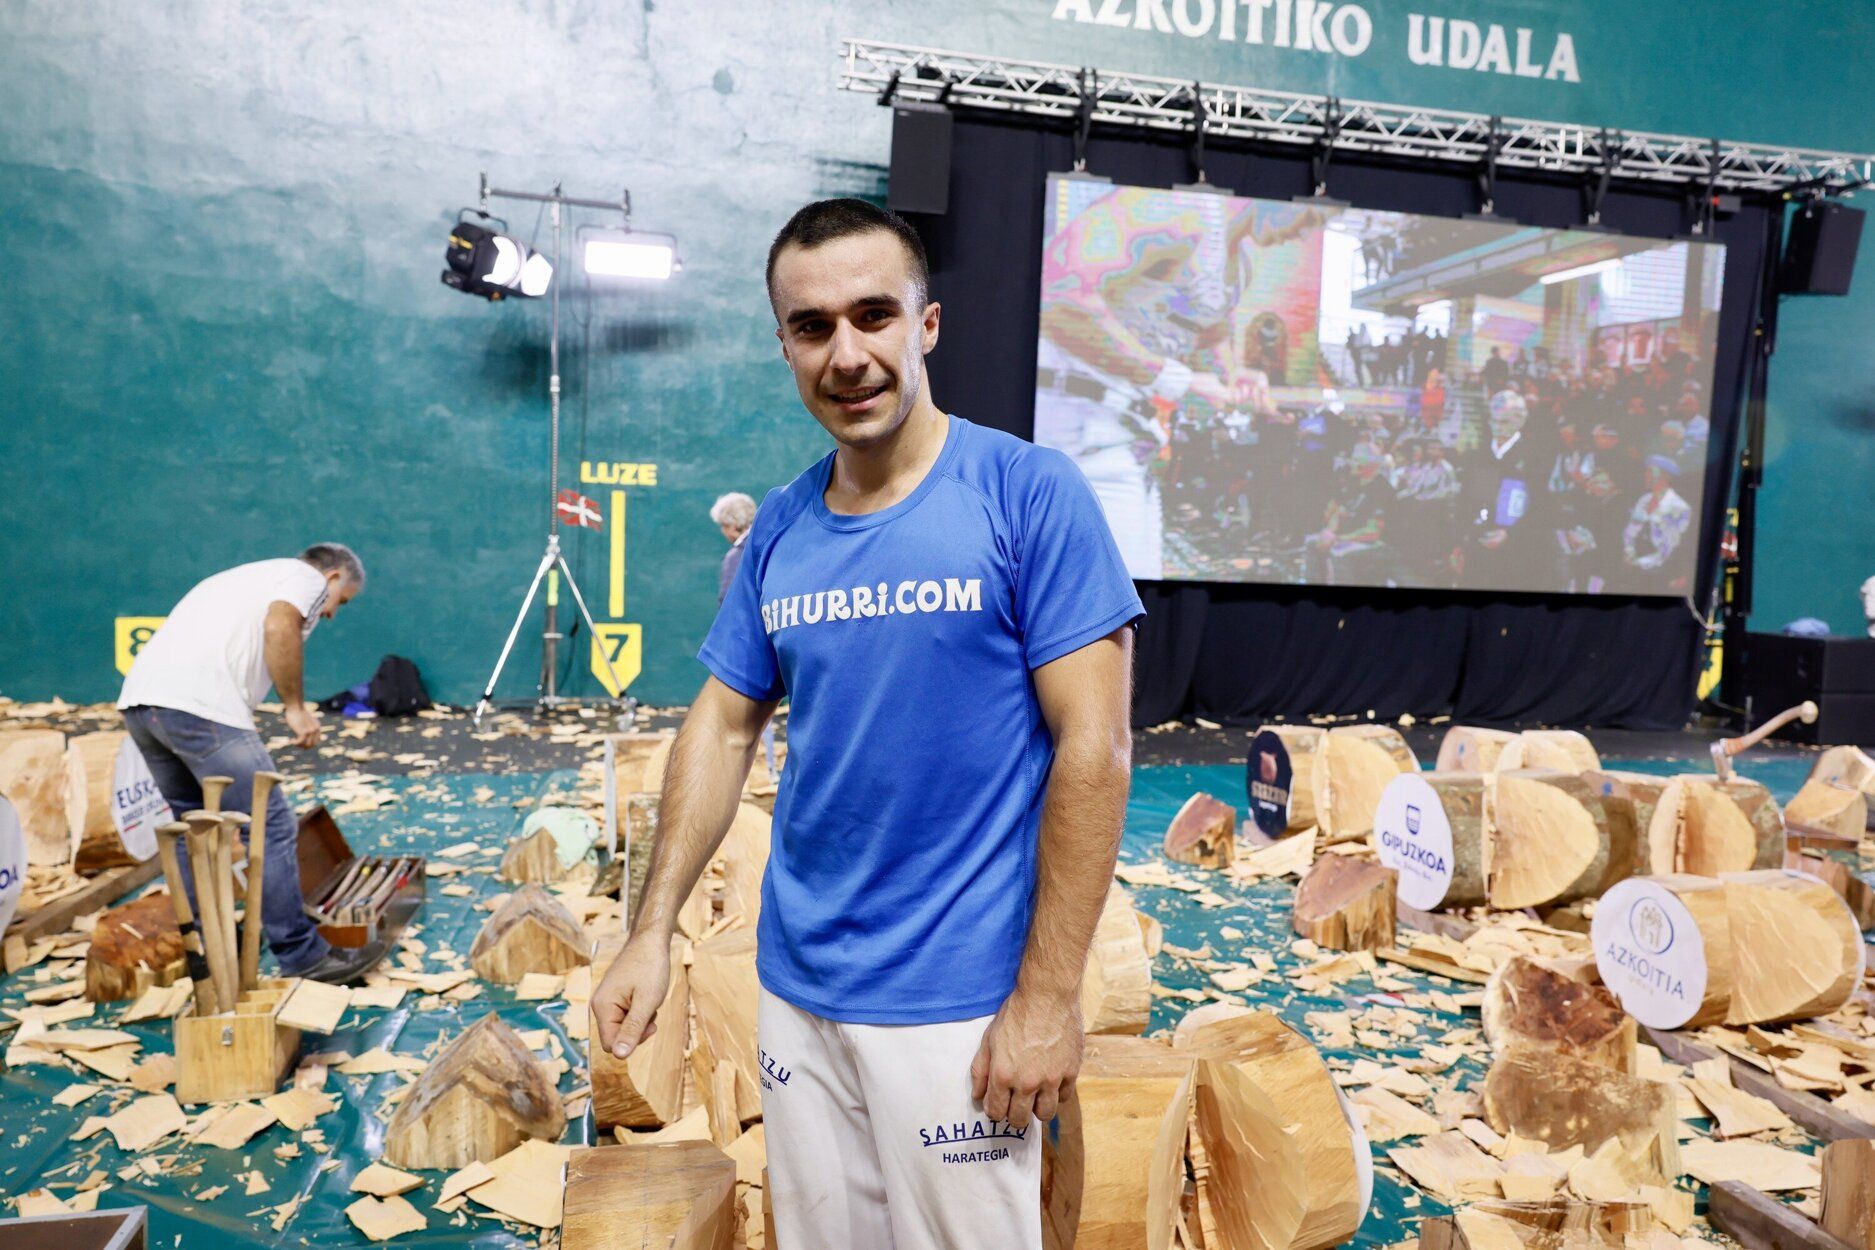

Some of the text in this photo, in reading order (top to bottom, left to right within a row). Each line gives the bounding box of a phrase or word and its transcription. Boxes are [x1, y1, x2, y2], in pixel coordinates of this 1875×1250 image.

[1407, 13, 1581, 83] UDALA
[580, 461, 658, 486] LUZE
[129, 627, 156, 657] 8
[605, 633, 629, 663] 7
[1382, 831, 1446, 875] GIPUZKOA
[1606, 943, 1684, 1000] AZKOITIA
[943, 1148, 1010, 1164] HARATEGIA
